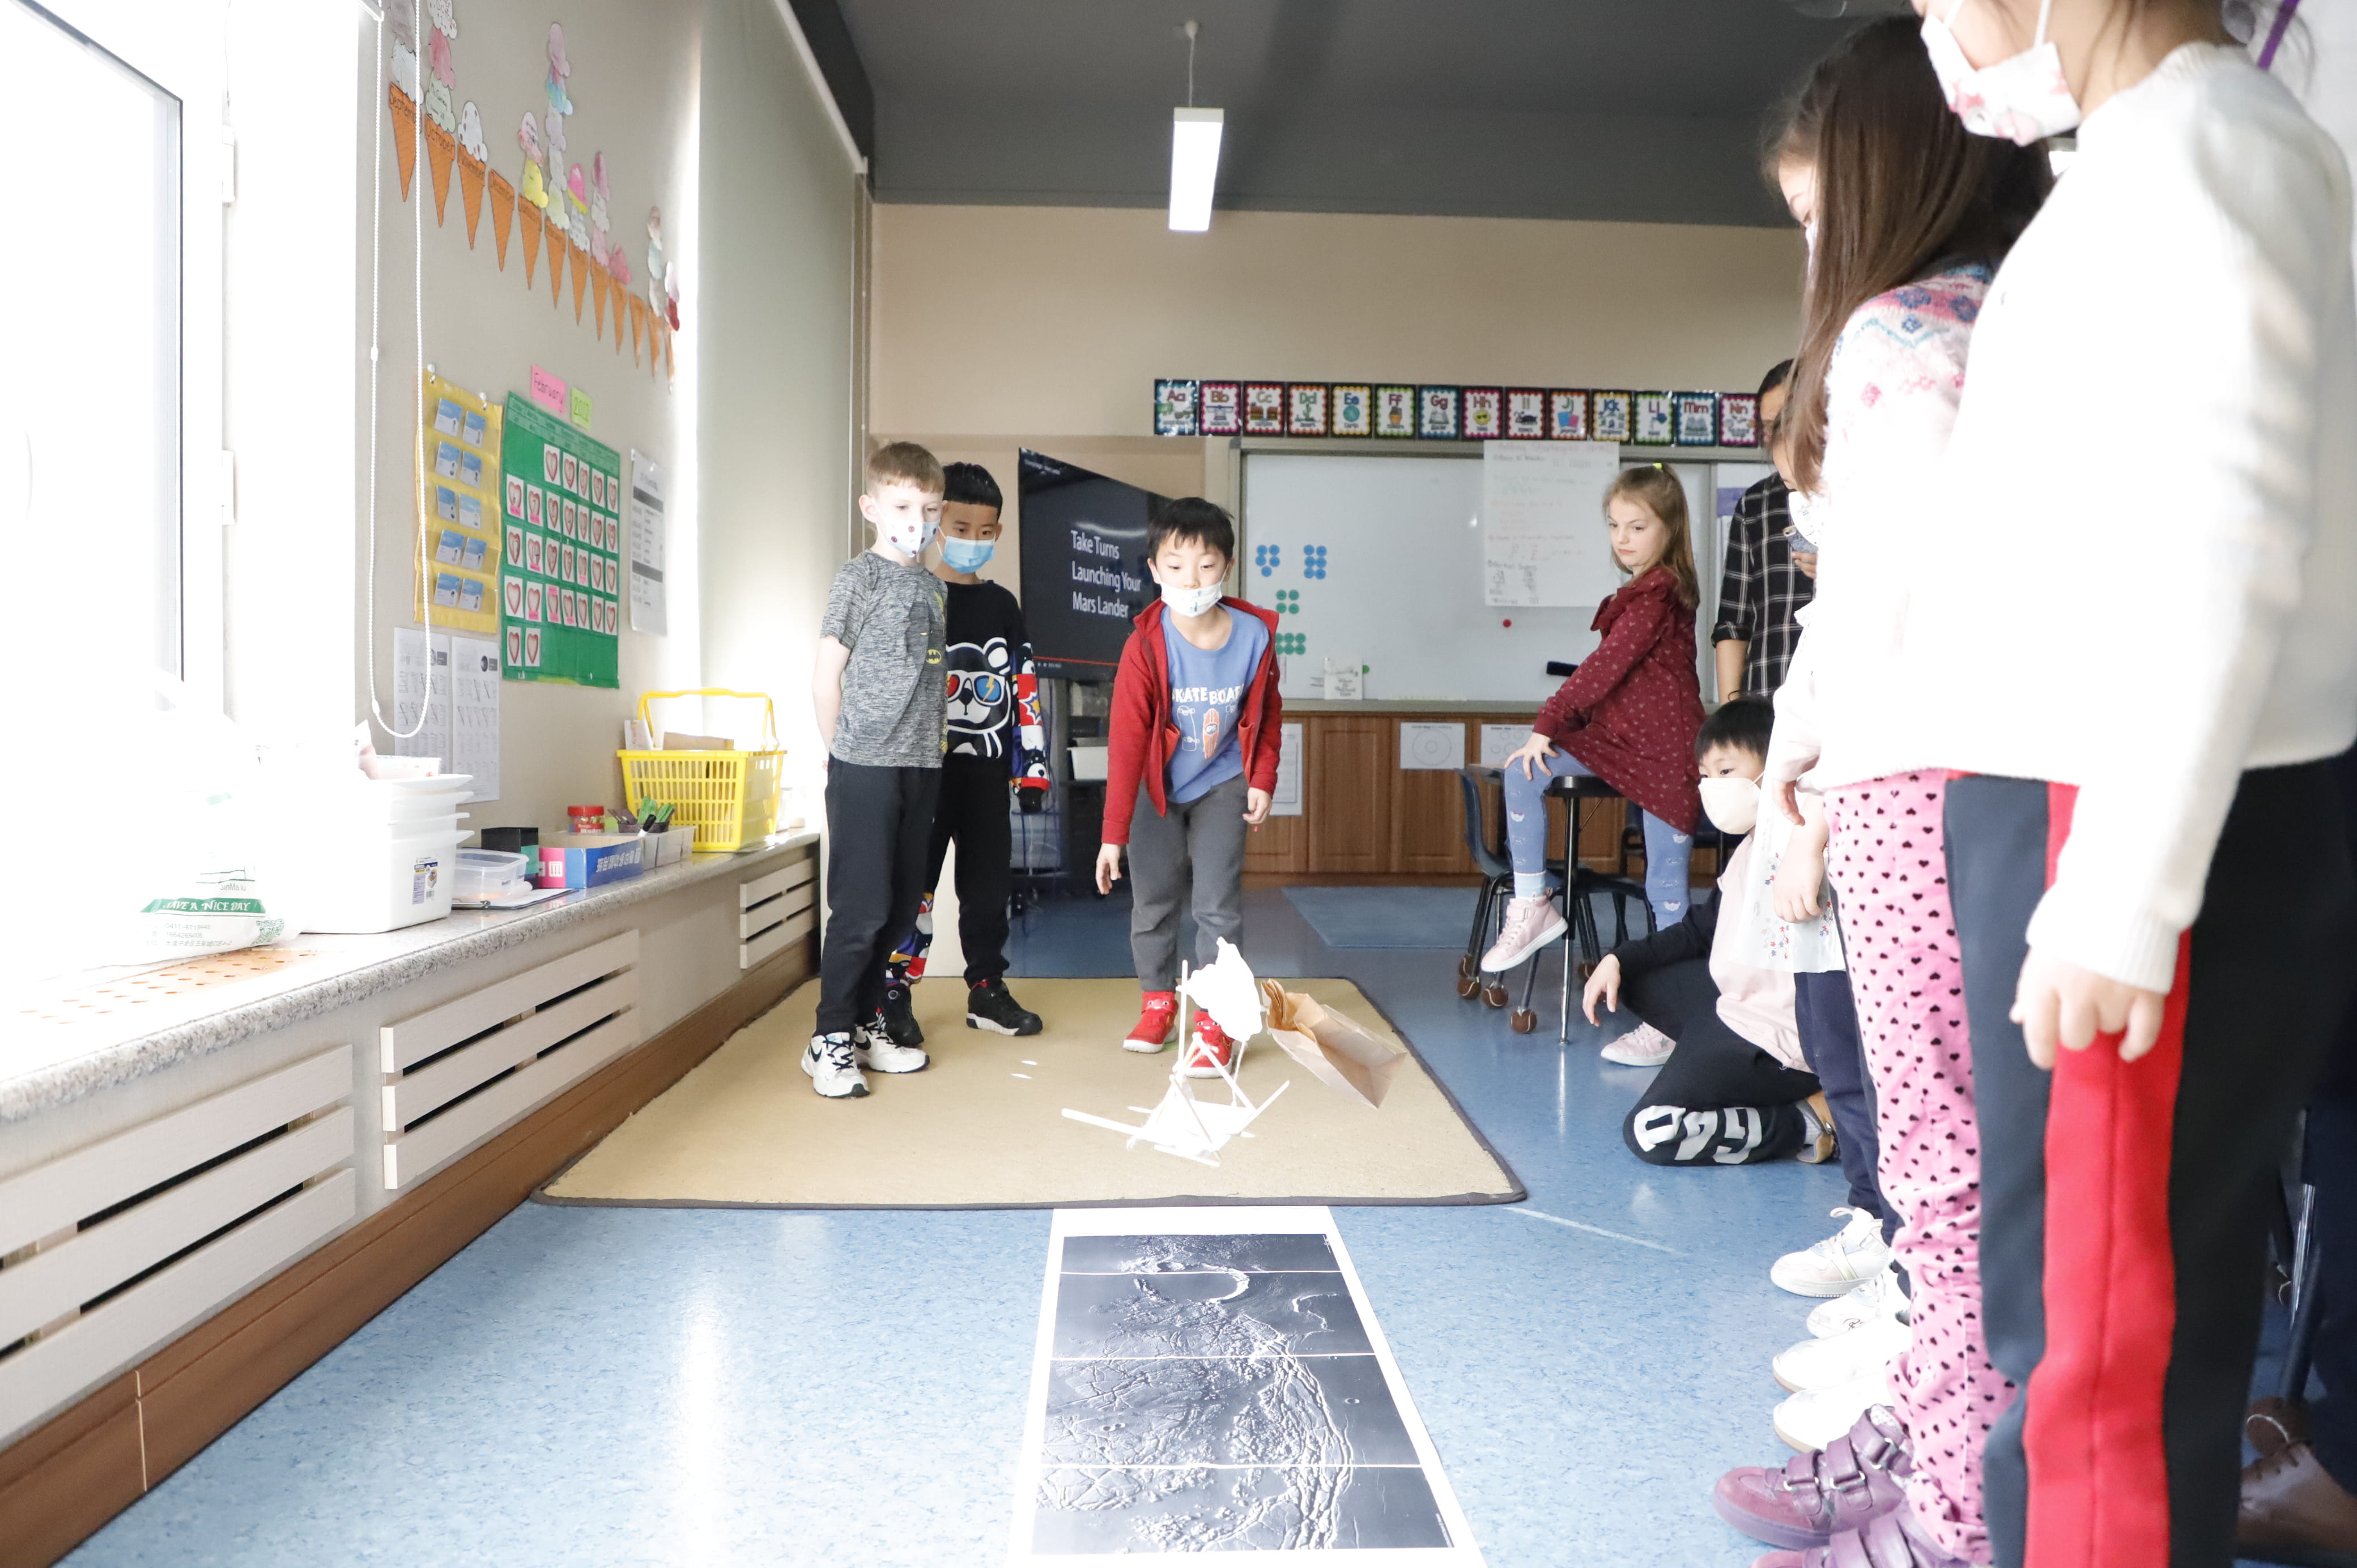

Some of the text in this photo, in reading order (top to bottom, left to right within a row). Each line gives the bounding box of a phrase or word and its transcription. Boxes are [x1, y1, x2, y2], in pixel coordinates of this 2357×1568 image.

[1167, 389, 1185, 402] Aa
[1211, 390, 1229, 403] Bb
[1256, 391, 1272, 403] Cc
[1299, 392, 1317, 404] Dd
[1345, 393, 1359, 405] Ee
[1389, 394, 1403, 406] Ff
[1431, 395, 1448, 410] Gg
[1473, 396, 1492, 408] Hh
[1562, 398, 1574, 412] Jj
[1603, 399, 1620, 412] Kk
[1683, 402, 1709, 414] Mm
[1730, 403, 1748, 414] Nn
[1070, 530, 1120, 560] Take Turns
[1072, 560, 1142, 593] Launching Your
[1073, 591, 1129, 618] Mars Lander
[190, 902, 198, 910] A
[202, 900, 229, 911] NICE
[231, 902, 251, 911] DAY
